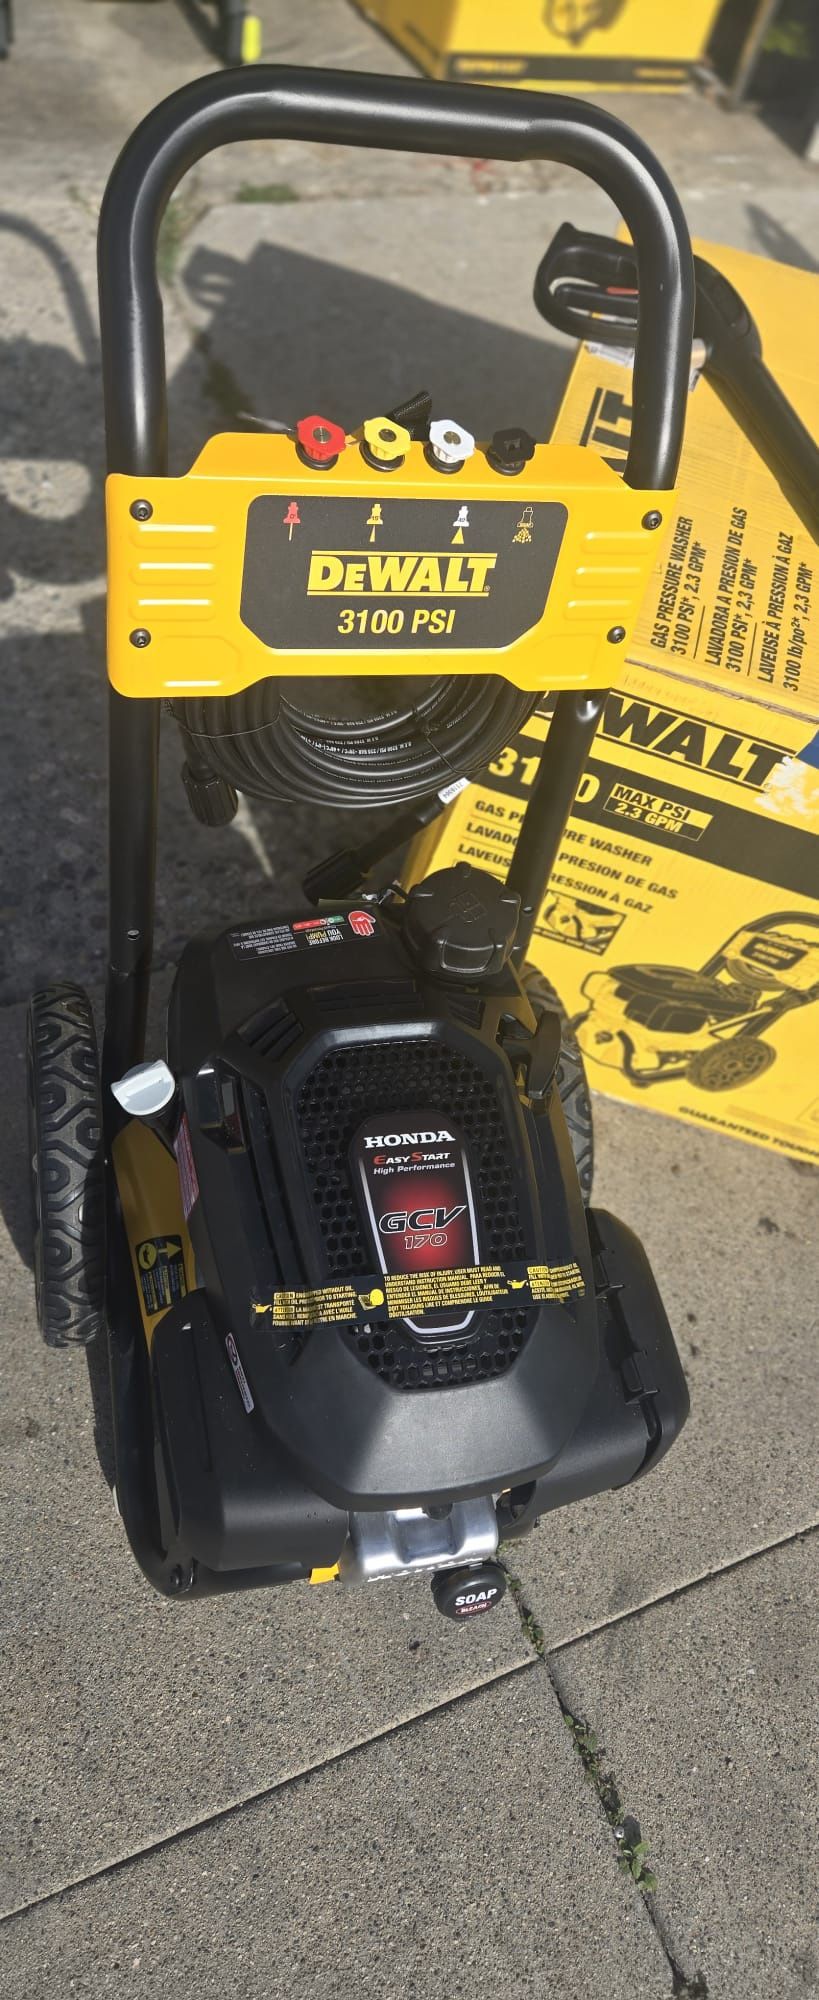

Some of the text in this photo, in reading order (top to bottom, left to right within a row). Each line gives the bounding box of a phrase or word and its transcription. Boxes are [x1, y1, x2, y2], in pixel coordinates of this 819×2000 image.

[651, 516, 693, 649] GAS PRESSURE WASHER
[705, 506, 748, 666] LAVADORA A PRESION DE GAS
[337, 609, 456, 634] 3100 PSI
[670, 624, 692, 655] 3100
[684, 573, 701, 594] 2.3
[757, 531, 794, 683] LAVEUSE À PRESSION À GAZ
[725, 641, 746, 673] 3100
[782, 658, 799, 691] 3100
[488, 746, 600, 803] 310
[614, 785, 693, 822] MAX PSI
[614, 802, 684, 834] 2.3 GPM
[475, 800, 505, 819] GAS
[590, 837, 654, 868] WASHER
[458, 844, 511, 867] LAVEUS
[624, 896, 655, 915] GAZ
[558, 852, 622, 881] PRESION
[624, 874, 646, 889] DE
[647, 882, 680, 900] GAS
[364, 1130, 456, 1149] HONDA
[373, 1161, 456, 1175] High Performance
[379, 1205, 467, 1234] GCV
[405, 1232, 448, 1250] 170
[455, 1588, 498, 1606] SOAP
